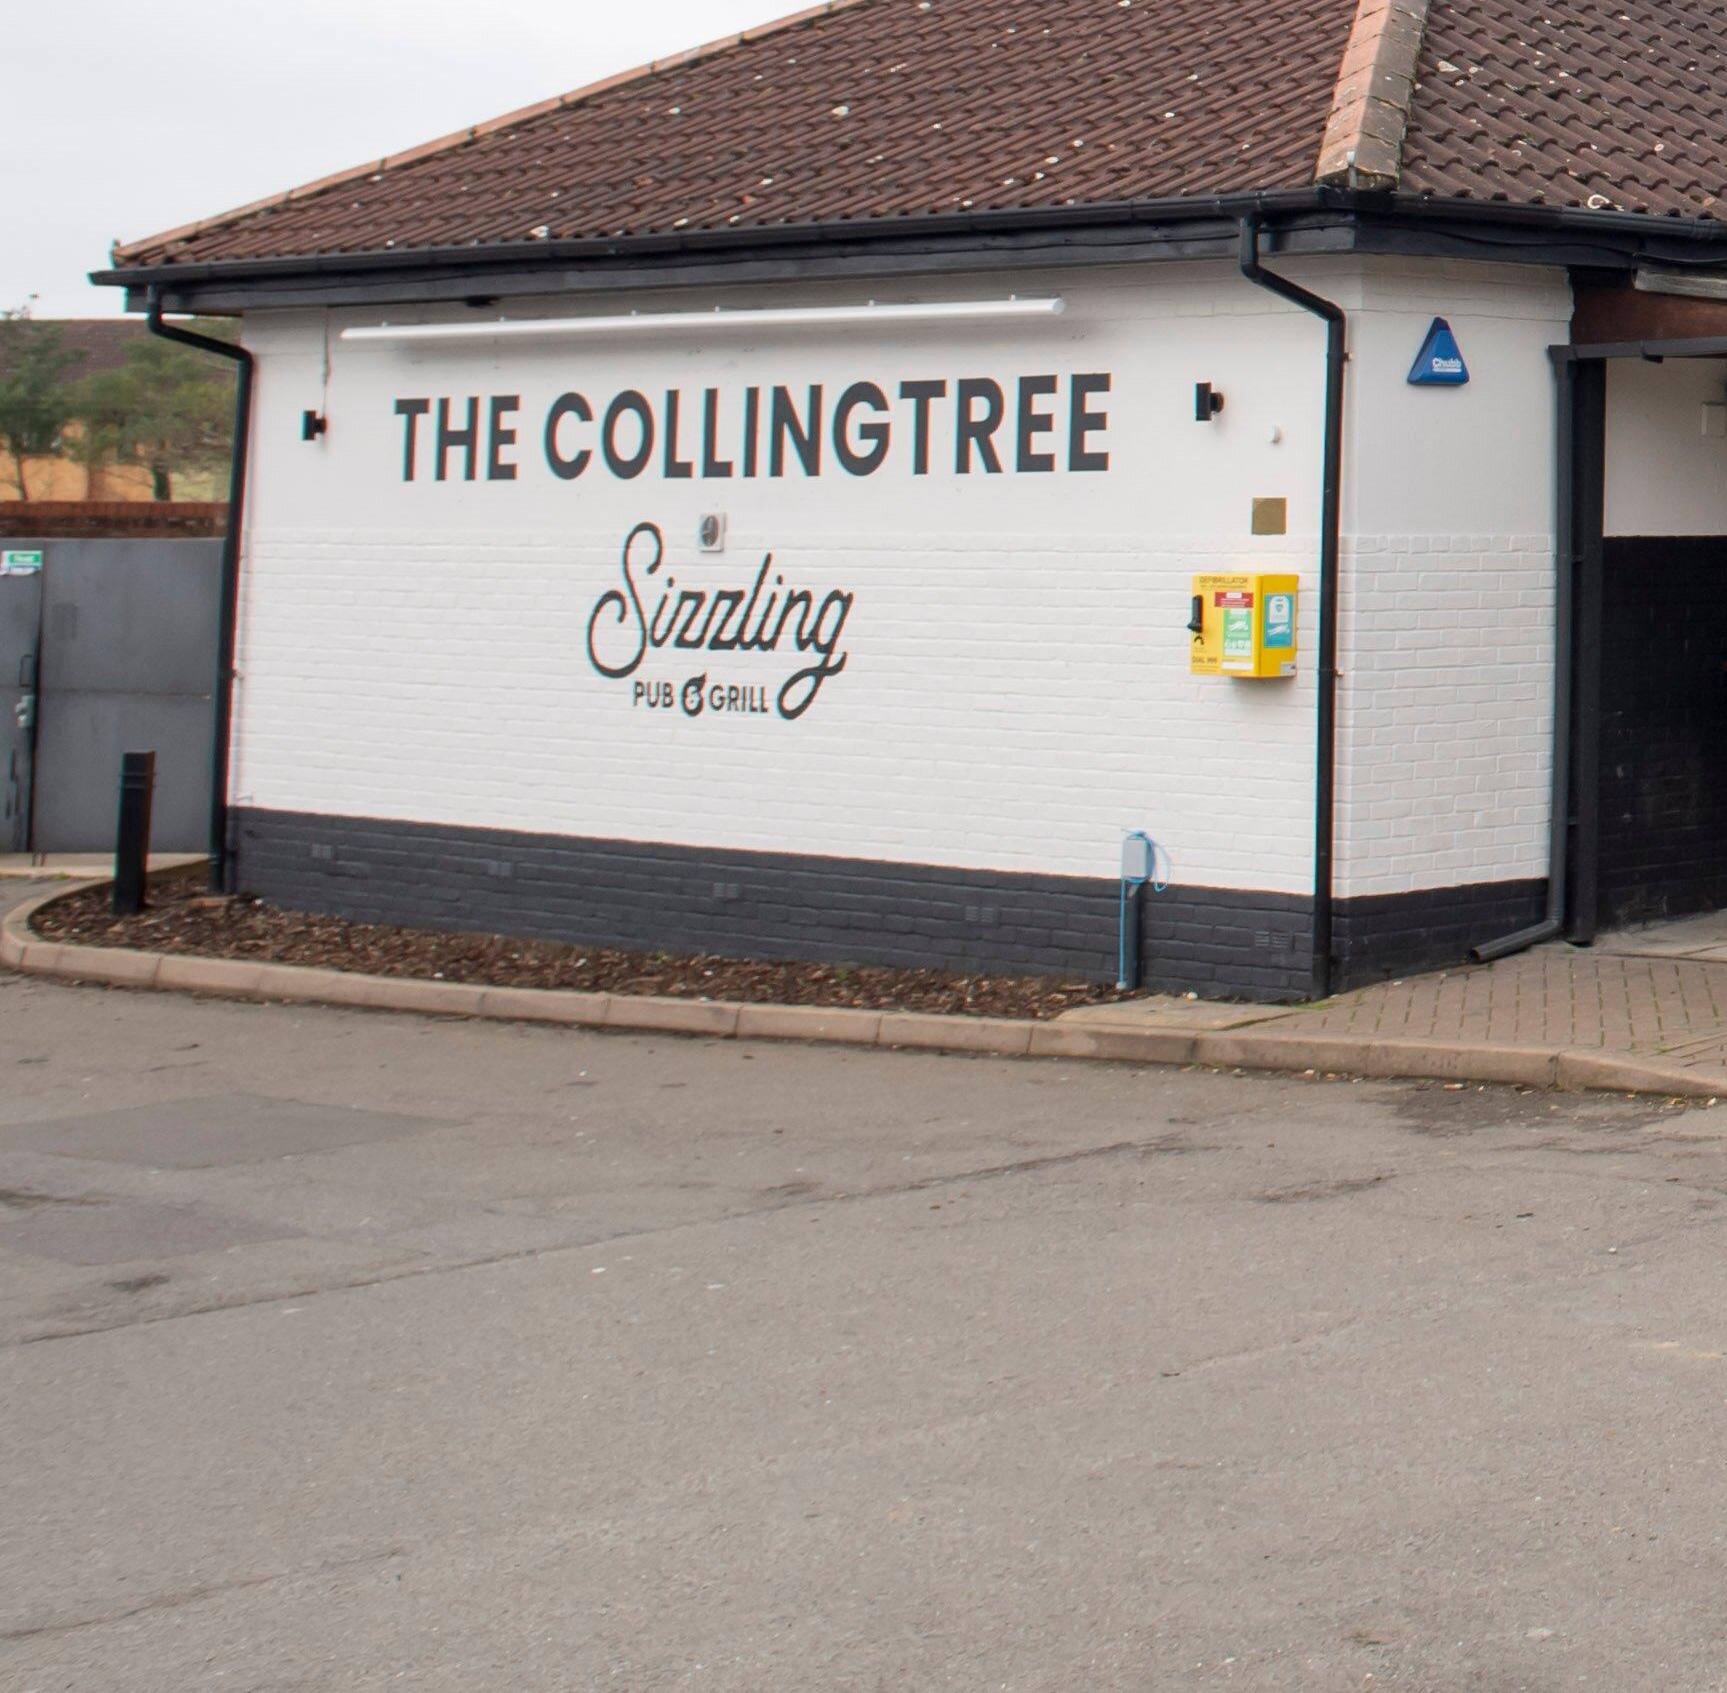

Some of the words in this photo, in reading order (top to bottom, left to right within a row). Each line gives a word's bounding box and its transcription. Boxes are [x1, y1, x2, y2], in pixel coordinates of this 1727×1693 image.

[394, 394, 519, 483] THE
[542, 372, 1112, 481] COLLINGTREE
[588, 522, 854, 720] Sizzling
[633, 681, 674, 709] PUB
[710, 684, 769, 714] GRILL
